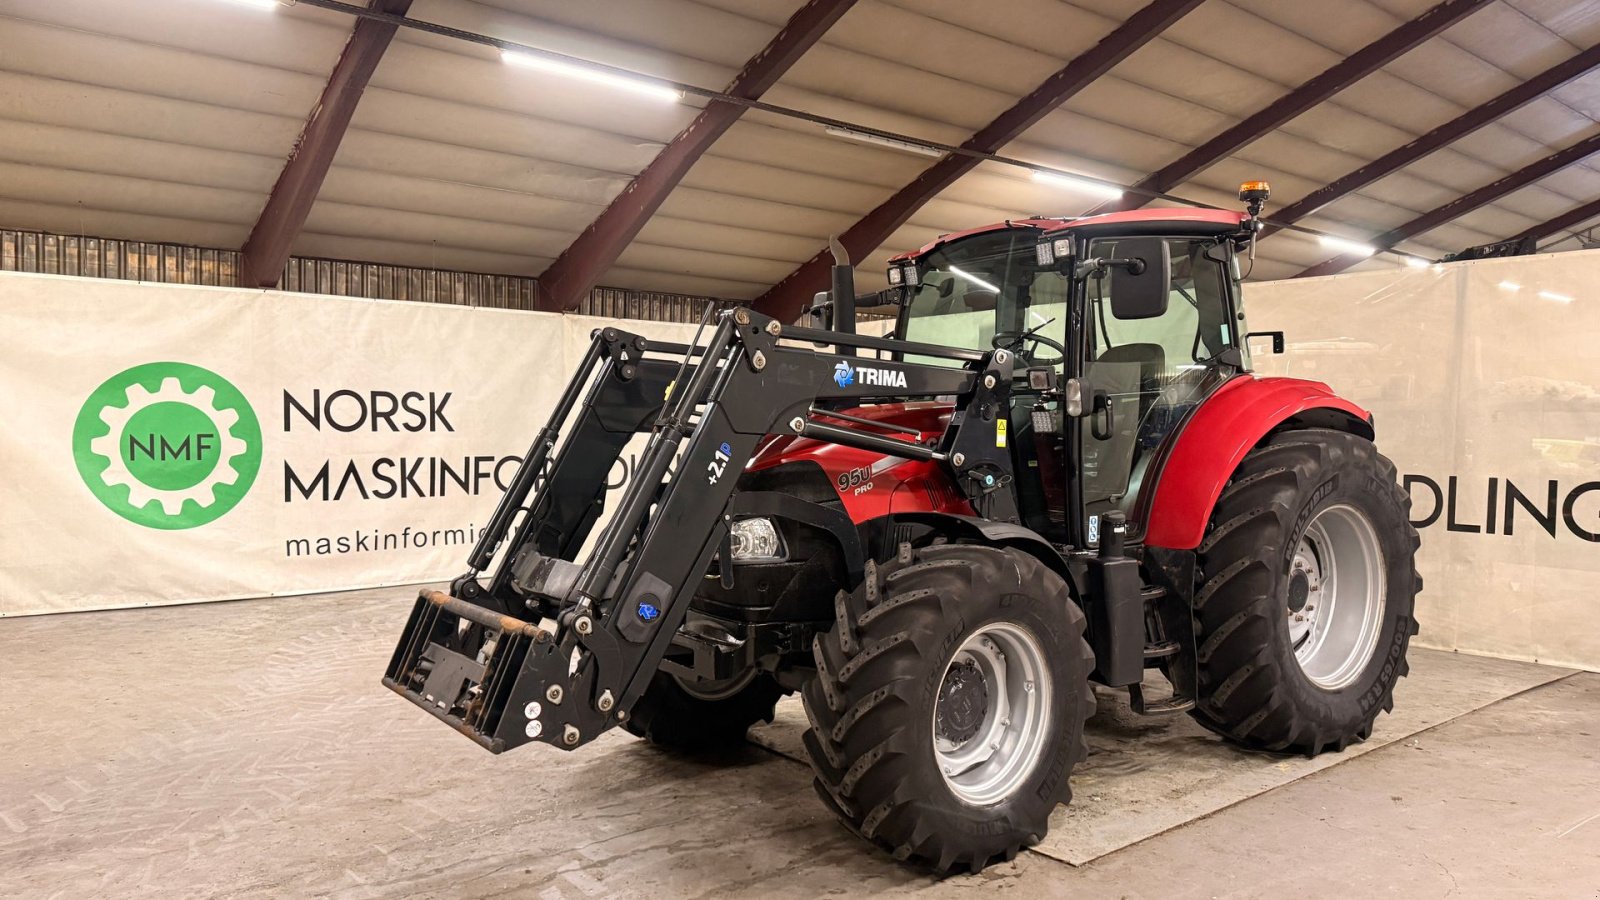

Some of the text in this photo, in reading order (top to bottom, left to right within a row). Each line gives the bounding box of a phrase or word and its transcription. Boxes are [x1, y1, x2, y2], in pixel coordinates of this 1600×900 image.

[856, 366, 908, 388] TRIMA
[283, 388, 456, 433] NORSK
[129, 433, 215, 462] NMF
[838, 466, 871, 492] 95U
[854, 482, 874, 496] PRO
